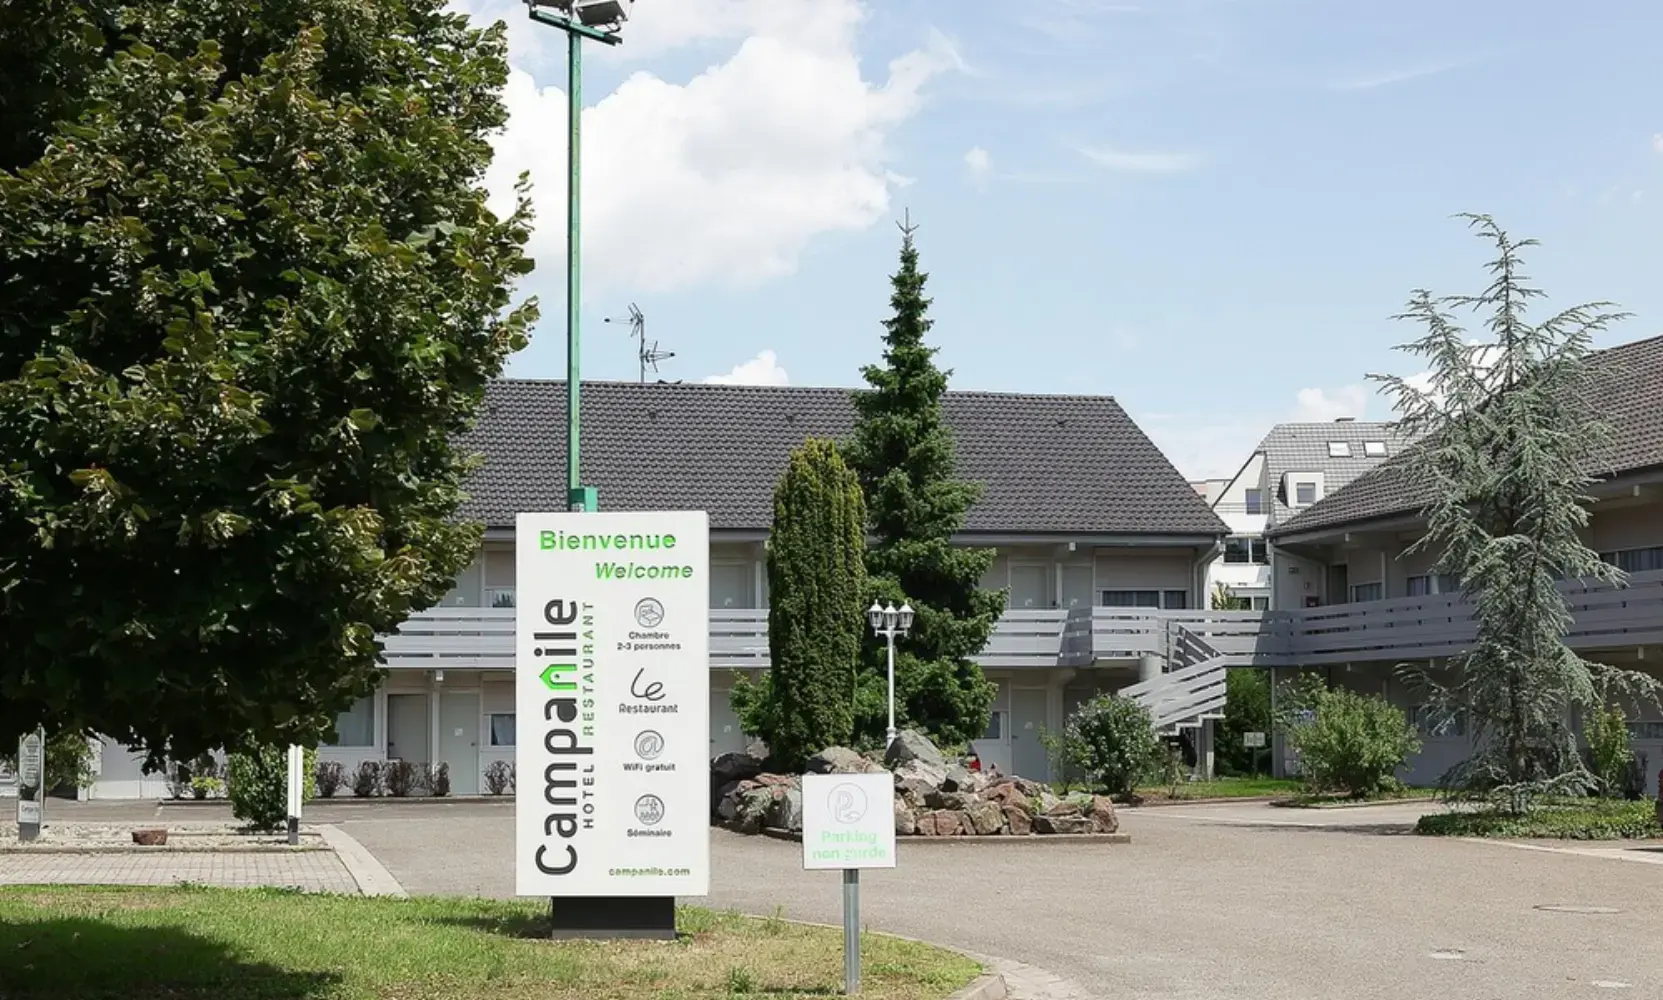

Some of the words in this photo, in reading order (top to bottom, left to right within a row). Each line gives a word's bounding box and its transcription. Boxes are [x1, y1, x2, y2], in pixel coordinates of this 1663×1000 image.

[540, 530, 677, 550] Bienvenue
[595, 562, 694, 579] Welcome
[628, 631, 670, 640] Chambre
[617, 642, 632, 650] 2-3
[634, 643, 682, 651] personnes
[583, 602, 595, 736] RESTAURANT
[619, 703, 679, 714] Restaurant
[533, 599, 594, 876] Campanile
[622, 763, 643, 771] WiFi
[645, 763, 676, 772] gratuit
[583, 764, 595, 829] HOTEL
[627, 828, 672, 837] Séminaire
[821, 830, 877, 844] Parking
[813, 849, 840, 859] non
[608, 867, 691, 878] campanile.com
